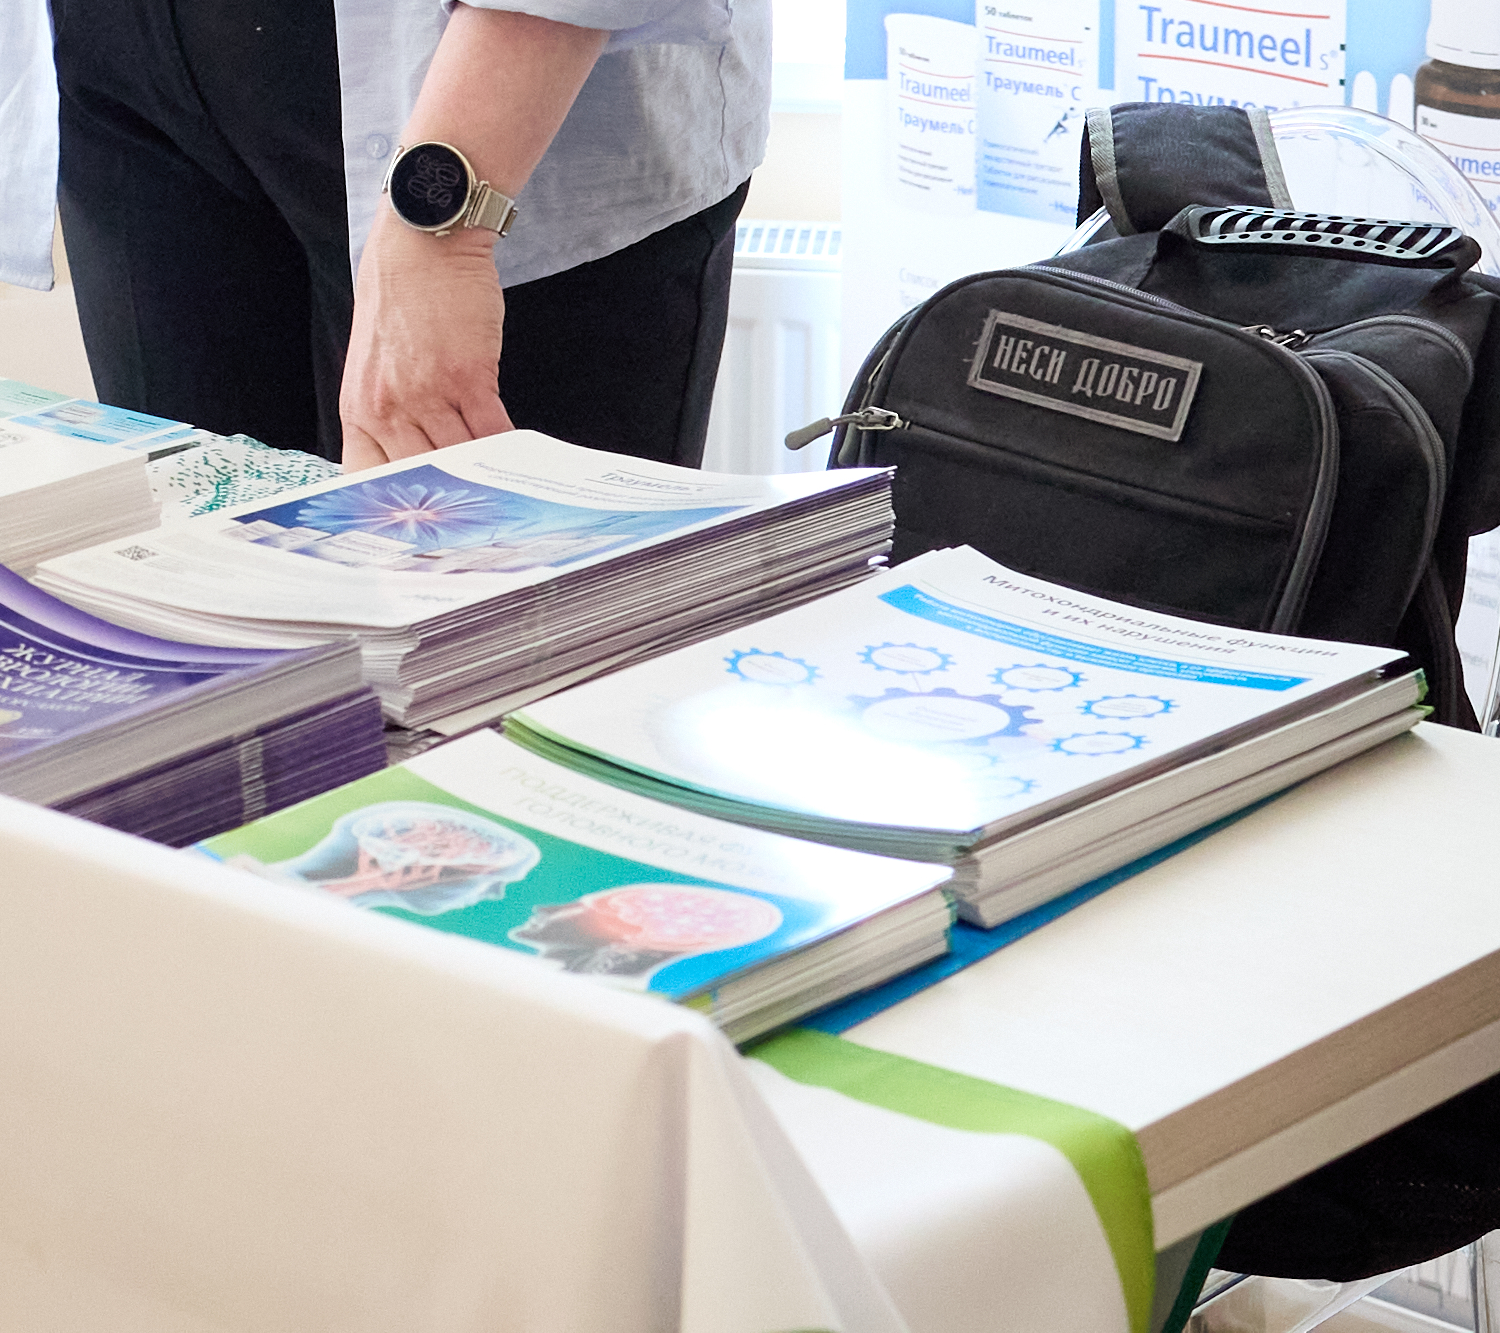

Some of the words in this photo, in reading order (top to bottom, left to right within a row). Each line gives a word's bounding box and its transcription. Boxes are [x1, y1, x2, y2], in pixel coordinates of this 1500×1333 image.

[985, 35, 1076, 66] Traumeel
[1139, 4, 1312, 68] Traumeel
[899, 72, 971, 102] Traumeel
[993, 335, 1067, 384] НЕСИ
[1072, 358, 1177, 411] ДОБРО
[982, 574, 1221, 644] Митохондриальные
[1225, 634, 1339, 660] функции
[1096, 621, 1237, 656] нарушения
